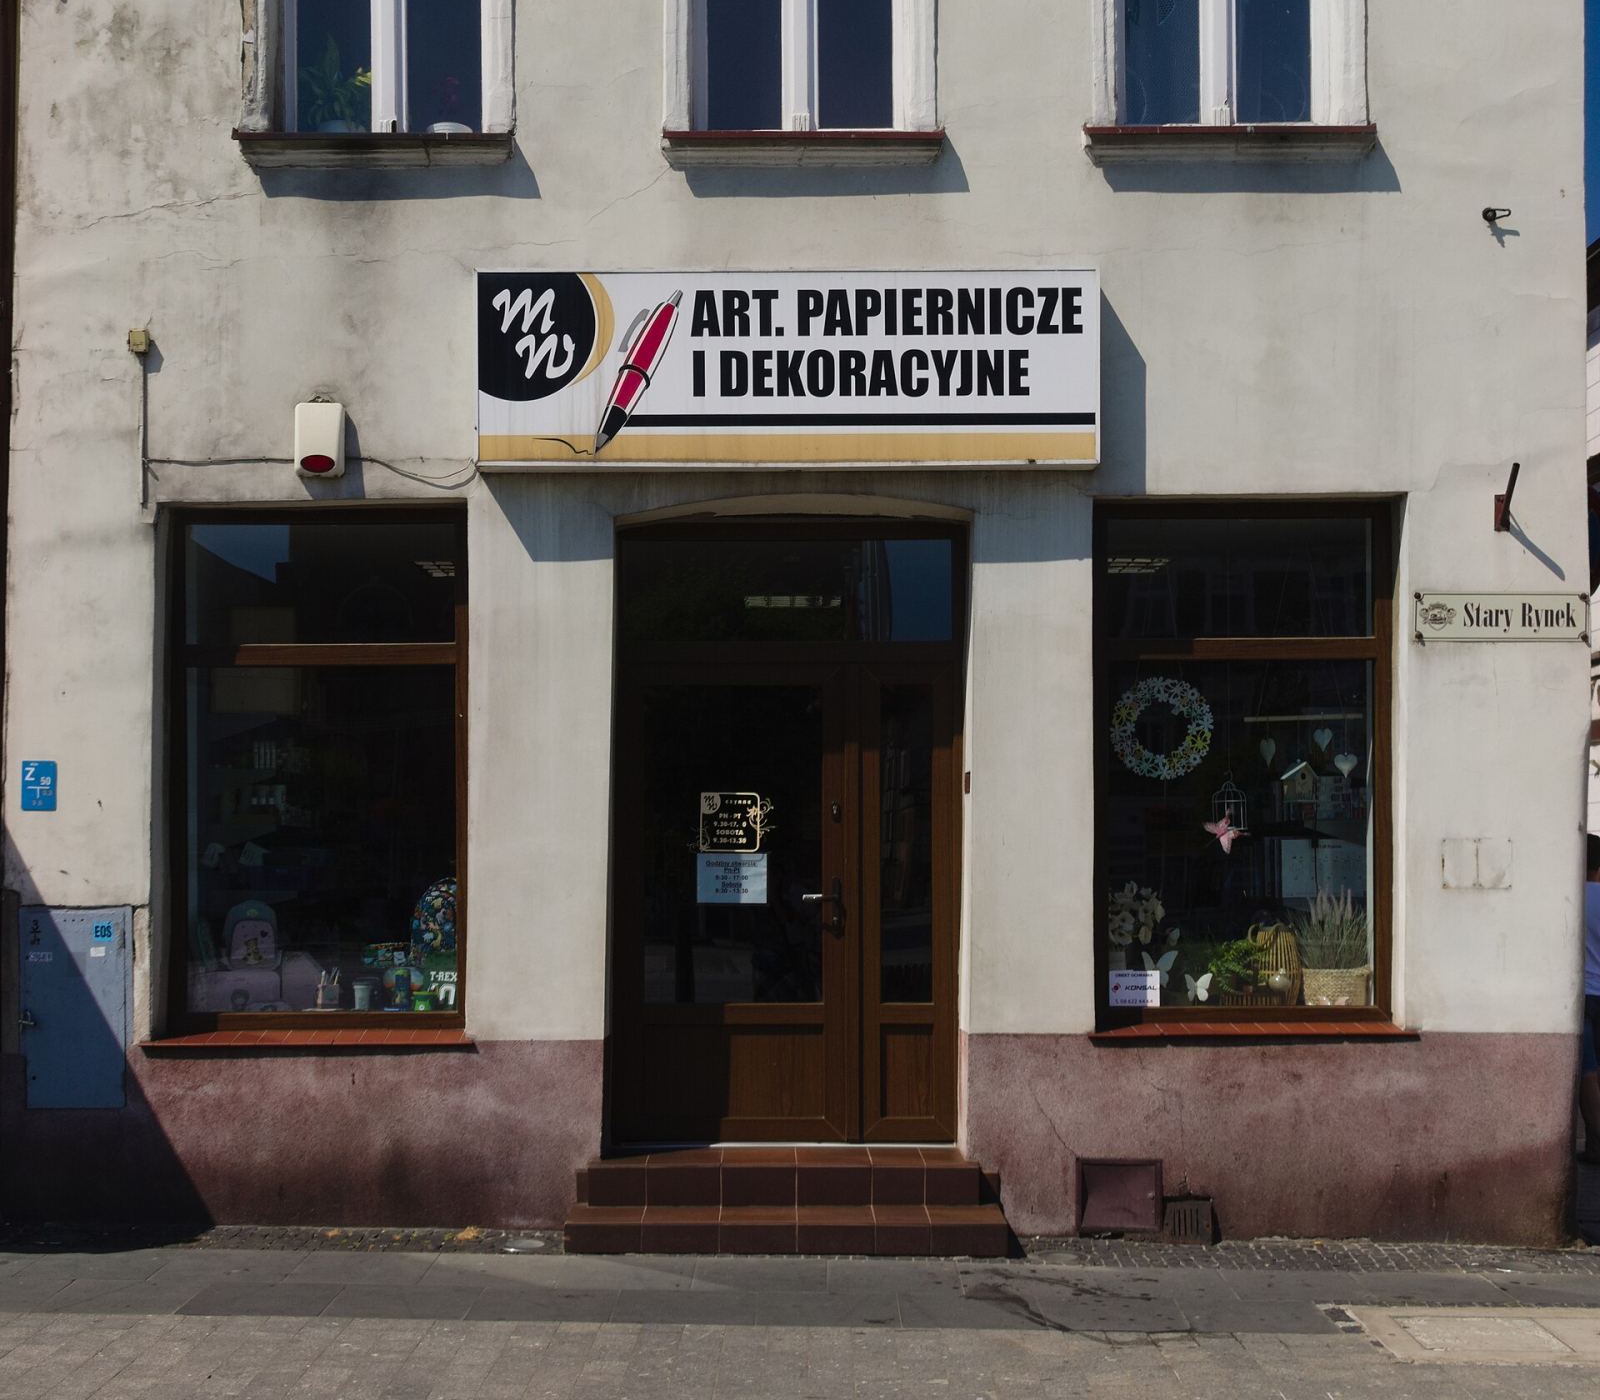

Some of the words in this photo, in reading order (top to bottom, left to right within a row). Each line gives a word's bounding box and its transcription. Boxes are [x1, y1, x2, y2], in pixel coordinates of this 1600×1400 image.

[690, 289, 785, 338] ART.
[797, 286, 1083, 337] PAPIERNICZE
[692, 350, 706, 397] I
[719, 348, 1030, 398] DEKORACYJNE
[1463, 602, 1513, 633] Stary
[1521, 602, 1577, 633] Rynek
[430, 971, 458, 982] T-REX
